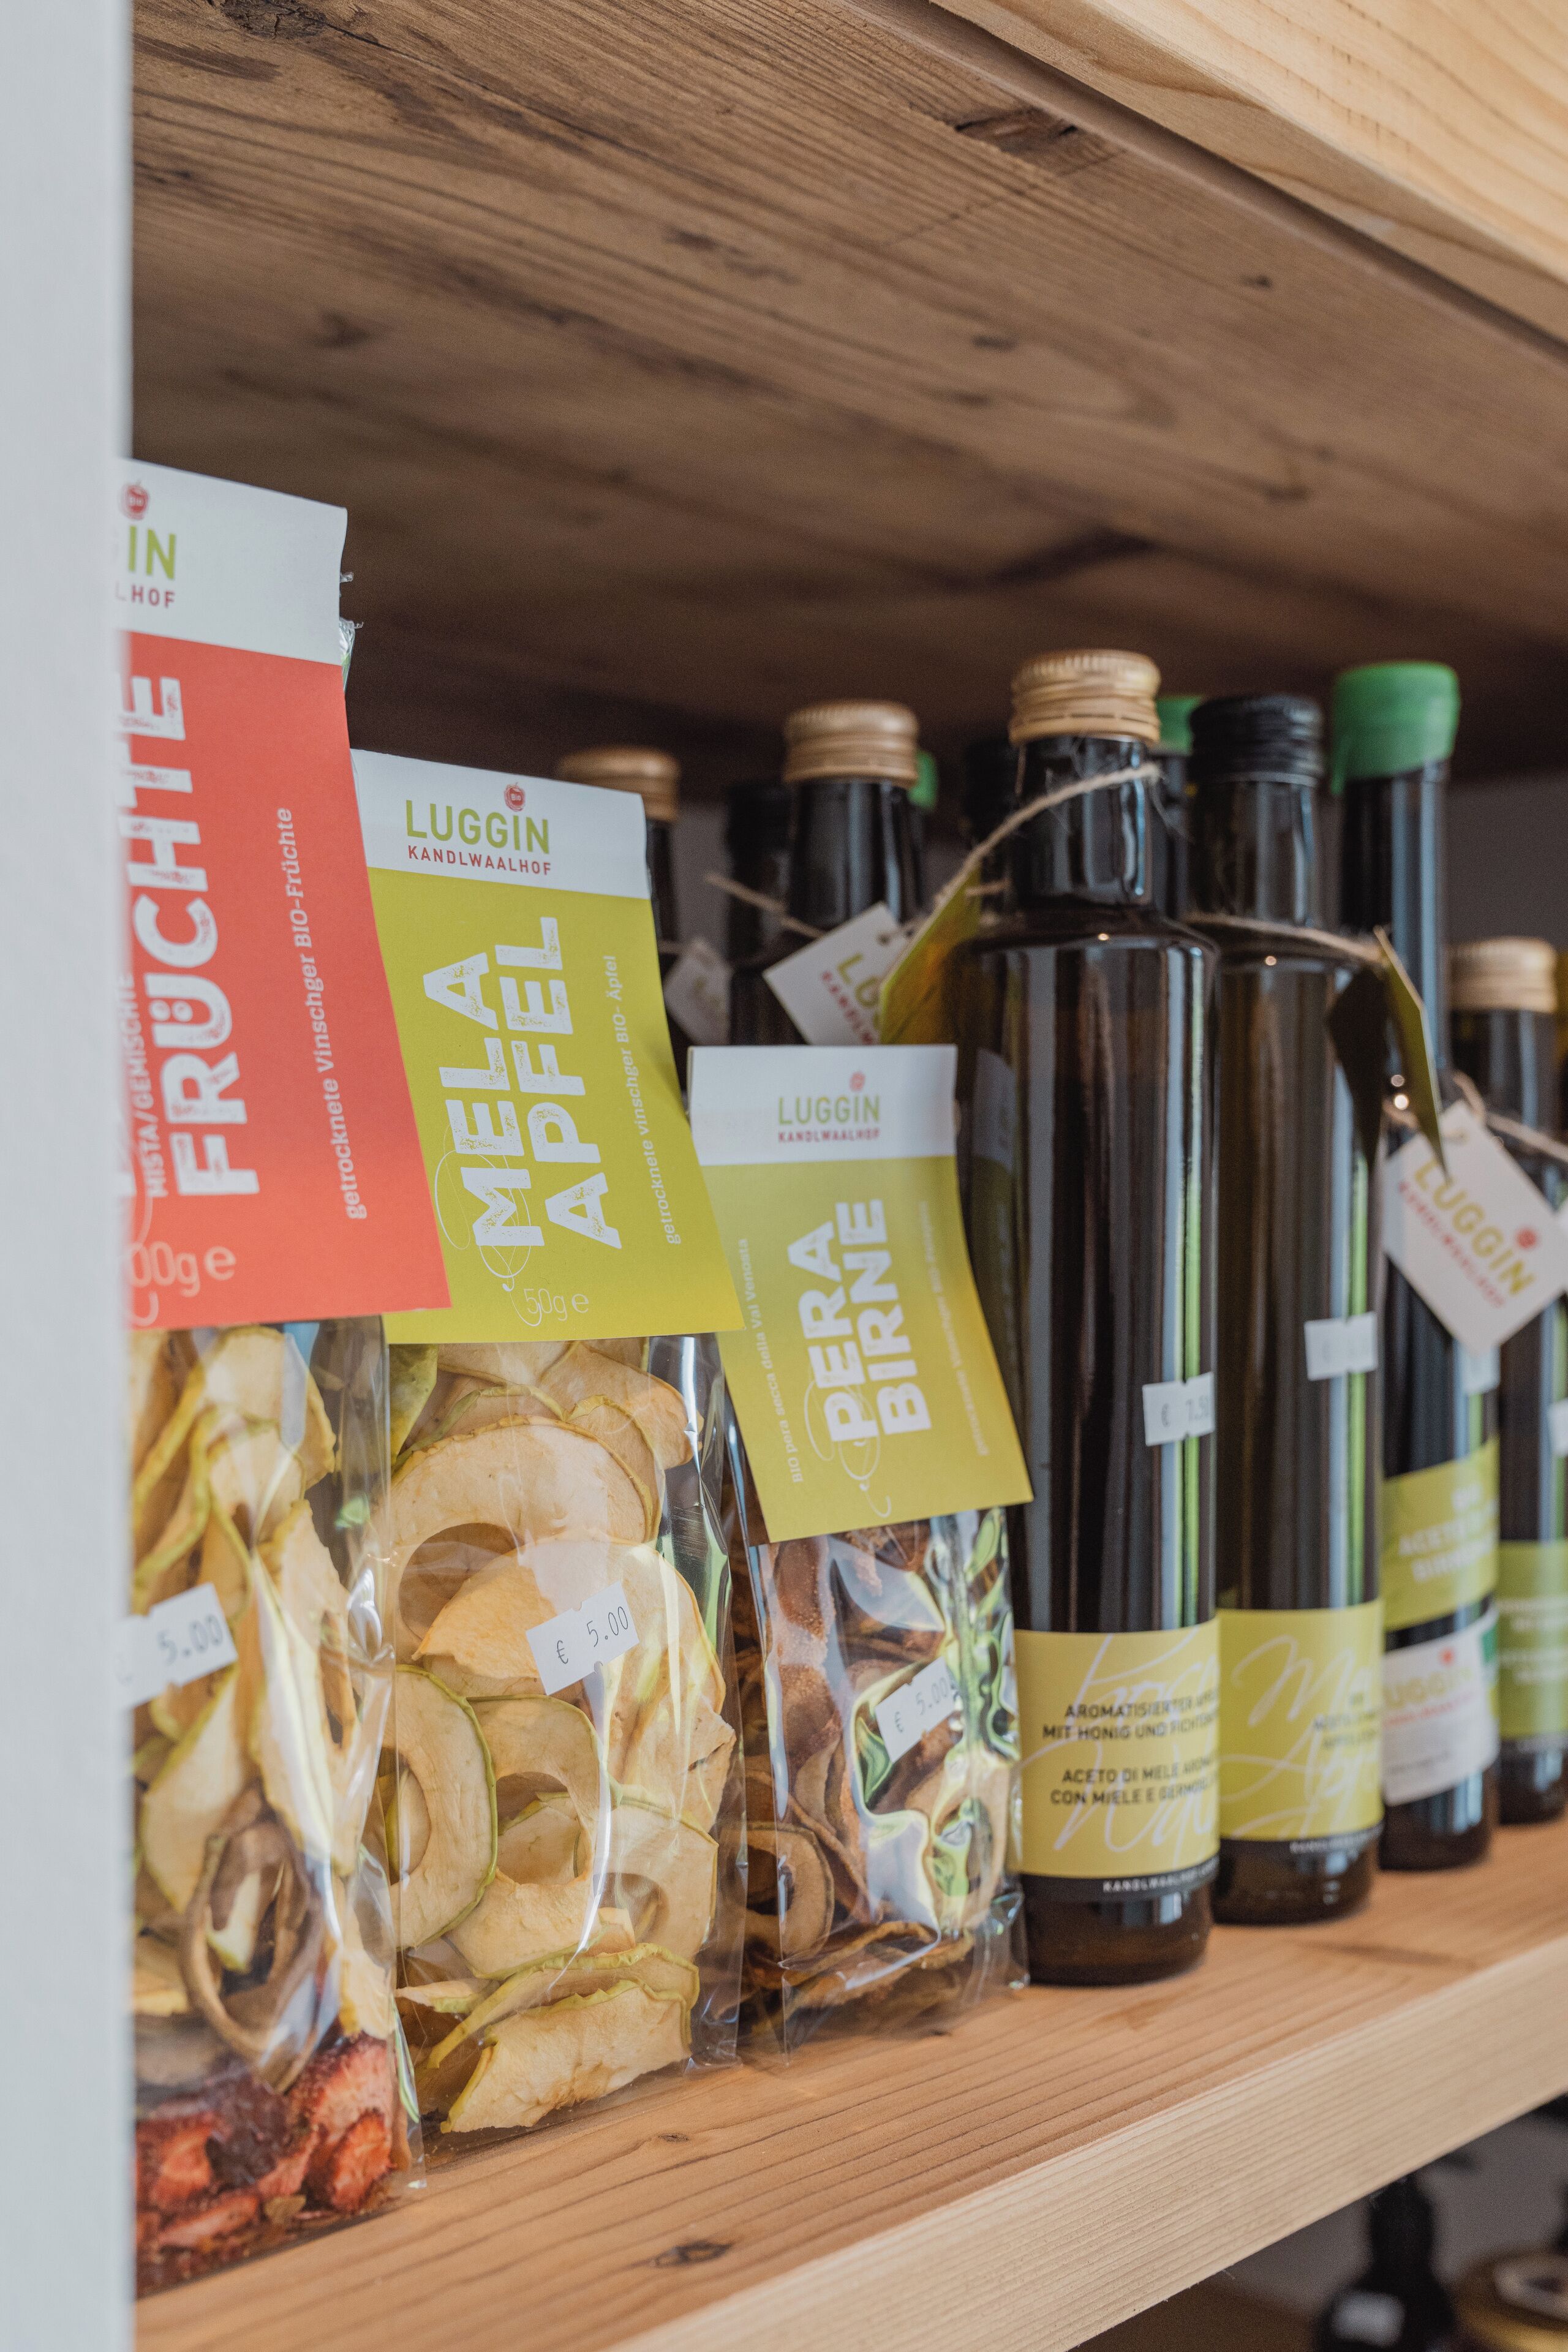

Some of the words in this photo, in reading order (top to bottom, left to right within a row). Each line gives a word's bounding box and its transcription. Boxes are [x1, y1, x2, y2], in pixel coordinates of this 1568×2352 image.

[405, 799, 550, 854] LUGGIN
[277, 808, 313, 949] BIO-Früchte
[408, 845, 551, 876] KANDLWAALHOF
[118, 676, 260, 1196] FRÜCHTE
[603, 955, 624, 1001] Äpfel
[303, 954, 335, 1074] Vinschger
[423, 952, 545, 1246] MELA
[495, 916, 622, 1249] APFEL
[778, 1094, 881, 1125] LUGGIN
[323, 1078, 368, 1219] getrocknete
[640, 1138, 680, 1244] getrocknete
[1412, 1158, 1536, 1295] LUGGIN
[129, 1241, 201, 1297] 00g
[738, 1238, 756, 1302] Venosta
[523, 1287, 566, 1321] 50g
[747, 1304, 763, 1329] Val
[787, 1220, 878, 1442] PERA
[835, 1199, 932, 1436] BIRNE
[756, 1332, 773, 1370] della
[767, 1373, 785, 1416] secca
[779, 1420, 798, 1453] pera
[787, 1457, 804, 1483] BIO
[156, 1612, 225, 1665] 5.00
[556, 1640, 568, 1664] €
[586, 1605, 628, 1648] 5.00
[915, 1676, 949, 1716] 5.00
[1042, 1724, 1071, 1739] MIT
[1078, 1724, 1130, 1740] HONIG
[1135, 1722, 1167, 1740] UND
[1050, 1789, 1086, 1804] CON
[1093, 1787, 1142, 1804] MIELE
[1145, 1786, 1155, 1804] E
[1061, 1768, 1117, 1784] ACETO
[1121, 1767, 1138, 1784] DI
[1142, 1762, 1178, 1781] MELE
